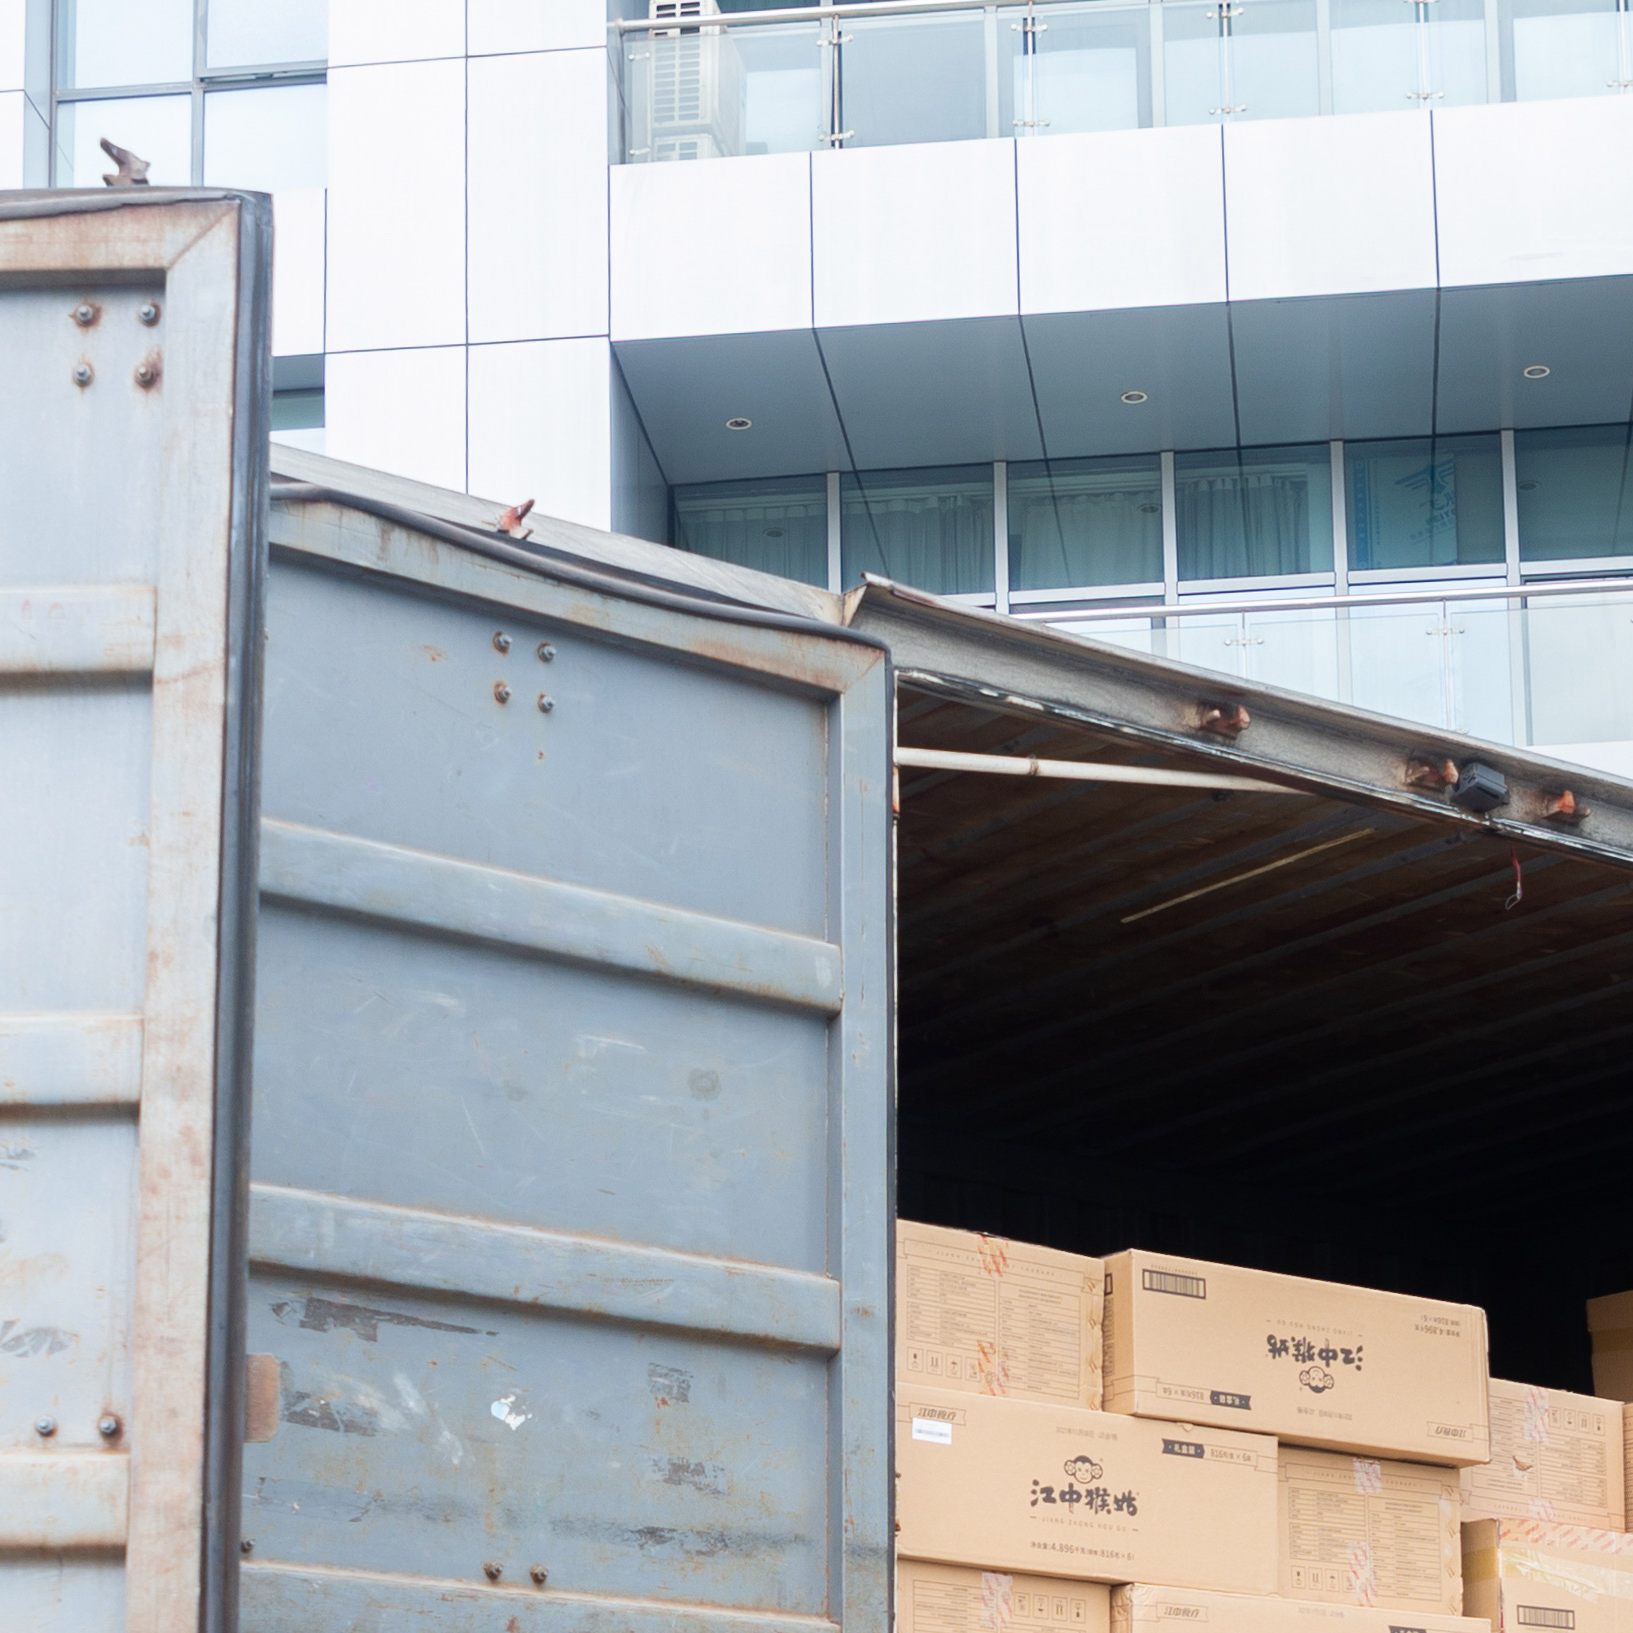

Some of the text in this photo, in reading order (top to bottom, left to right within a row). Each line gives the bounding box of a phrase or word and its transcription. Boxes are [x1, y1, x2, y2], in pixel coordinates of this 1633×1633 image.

[1266, 1333, 1364, 1372] 江中猴姑
[1029, 1478, 1139, 1517] 江中猴姑
